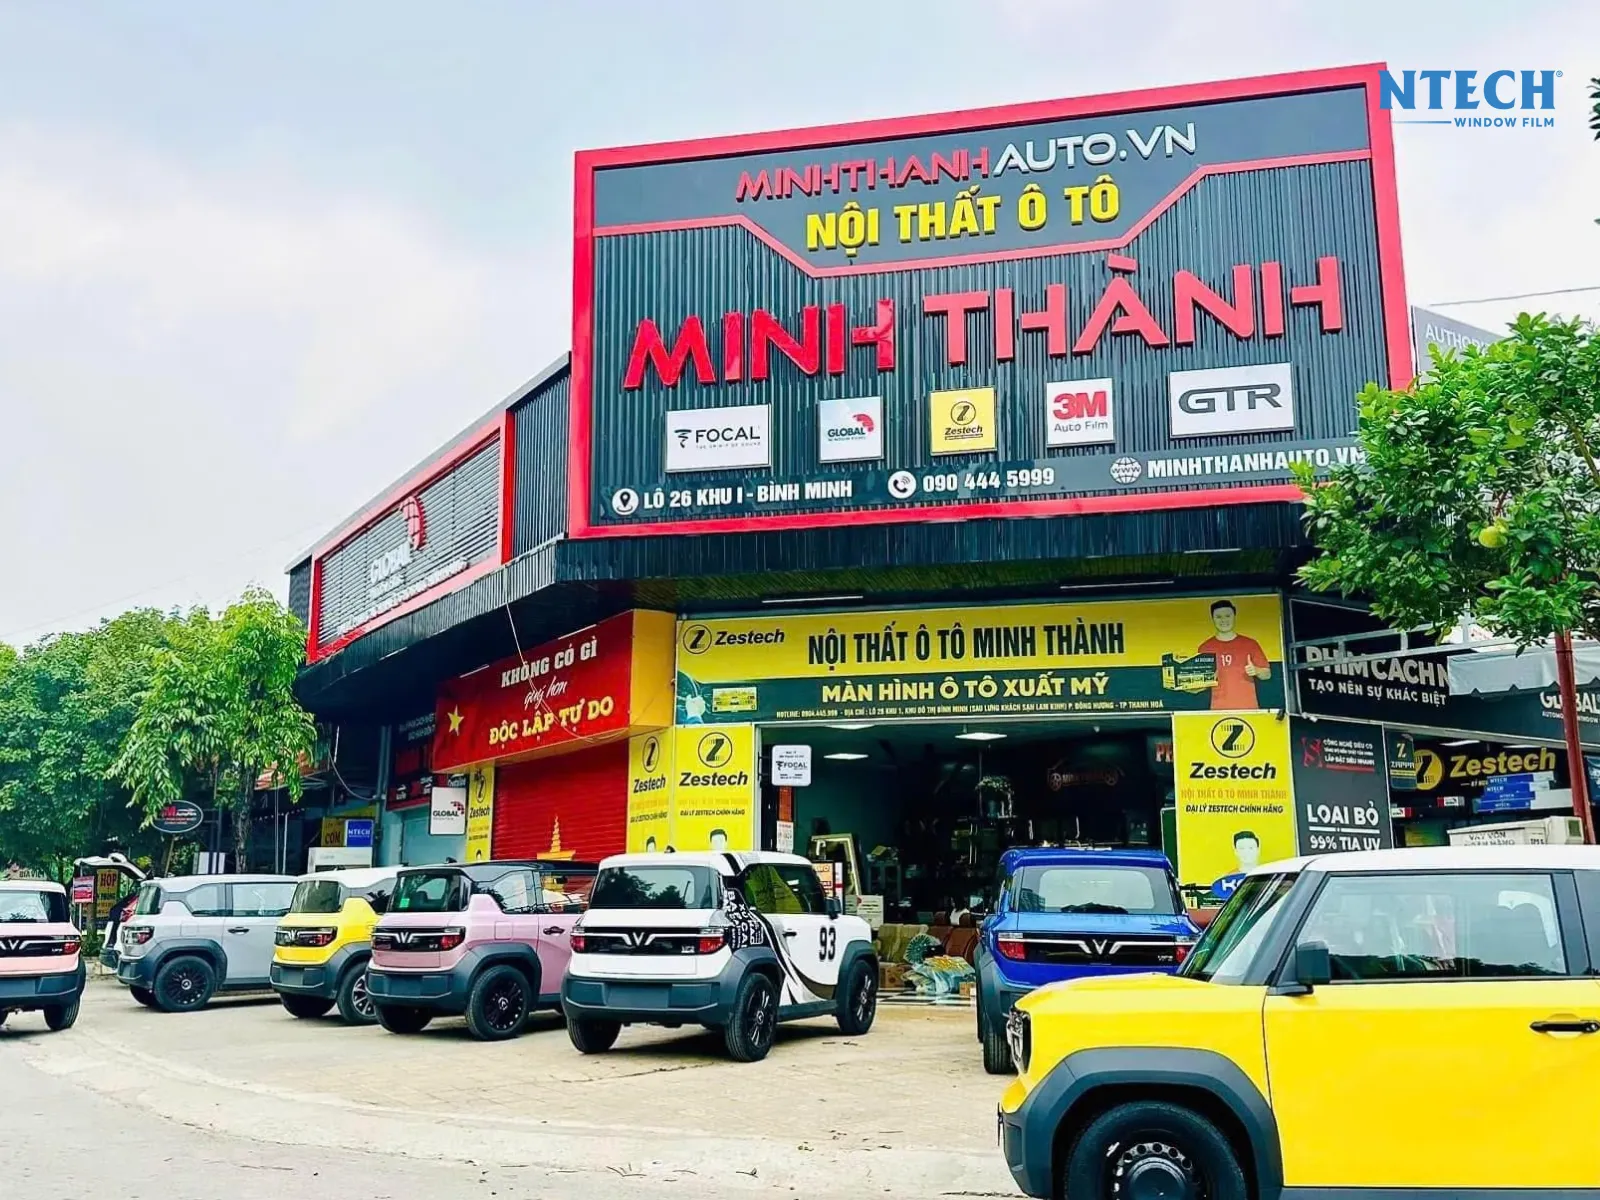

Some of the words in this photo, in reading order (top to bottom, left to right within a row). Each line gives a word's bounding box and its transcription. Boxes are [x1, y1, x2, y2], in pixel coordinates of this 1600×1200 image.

[806, 202, 880, 256] NỘI
[894, 184, 1000, 243] THẤT
[1017, 183, 1047, 231] Ô
[1064, 175, 1120, 225] TÔ
[623, 298, 895, 390] MINH
[923, 254, 1343, 366] THÀNH
[1053, 391, 1107, 419] 3M
[1179, 383, 1282, 414] GTR
[695, 427, 761, 443] FOCAL
[828, 427, 866, 437] GLOBAL
[945, 425, 983, 436] Zestech
[1053, 423, 1081, 433] Auto
[1085, 421, 1108, 430] Film
[923, 473, 958, 492] 090
[963, 472, 1000, 490] 444
[1006, 468, 1055, 488] 5999
[643, 487, 664, 509] LÔ
[670, 490, 690, 507] 26
[696, 487, 732, 506] KHU
[757, 481, 799, 502] BÌNH
[804, 480, 853, 500] MINH
[715, 629, 785, 646] Zestech
[808, 628, 846, 671] NỘI
[853, 620, 908, 663] THẤT
[916, 623, 930, 660] Ô
[937, 622, 965, 660] TÔ
[973, 626, 1036, 658] MINH
[1043, 617, 1124, 656] THÀNH
[501, 657, 550, 688] KHÔNG
[554, 643, 575, 669] CÓ
[580, 636, 598, 660] GÌ
[1221, 654, 1232, 666] 19
[822, 680, 874, 703] MÀN
[879, 678, 934, 701] HÌNH
[939, 676, 959, 699] Ô
[964, 675, 998, 698] TÔ
[1003, 671, 1065, 697] XUẤT
[1071, 671, 1109, 695] MỸ
[1308, 678, 1334, 694] TẠO
[1338, 680, 1363, 696] NÊN
[1367, 685, 1383, 700] SỰ
[1386, 687, 1418, 702] KHÁC
[1421, 690, 1447, 707] BIỆT
[905, 706, 917, 714] KHU
[1540, 691, 1600, 714] GLBAL
[489, 717, 518, 749] ĐỘC
[522, 710, 555, 741] LẬP
[559, 698, 585, 732] TỰ
[588, 696, 614, 722] DO
[1190, 762, 1276, 780] Zestech
[1450, 746, 1556, 778] Zestech
[633, 776, 667, 794] Zestech
[678, 772, 748, 787] Zestech
[1185, 804, 1198, 814] ĐẠI
[1199, 803, 1207, 812] LÝ
[1208, 804, 1238, 813] ZESTECH
[1239, 803, 1262, 813] CHÍNH
[1262, 803, 1284, 813] HÃNG
[1353, 801, 1379, 826] BỎ
[1309, 835, 1338, 850] 99%
[1339, 836, 1361, 850] TIA
[1363, 837, 1381, 850] UV
[818, 926, 836, 961] 93
